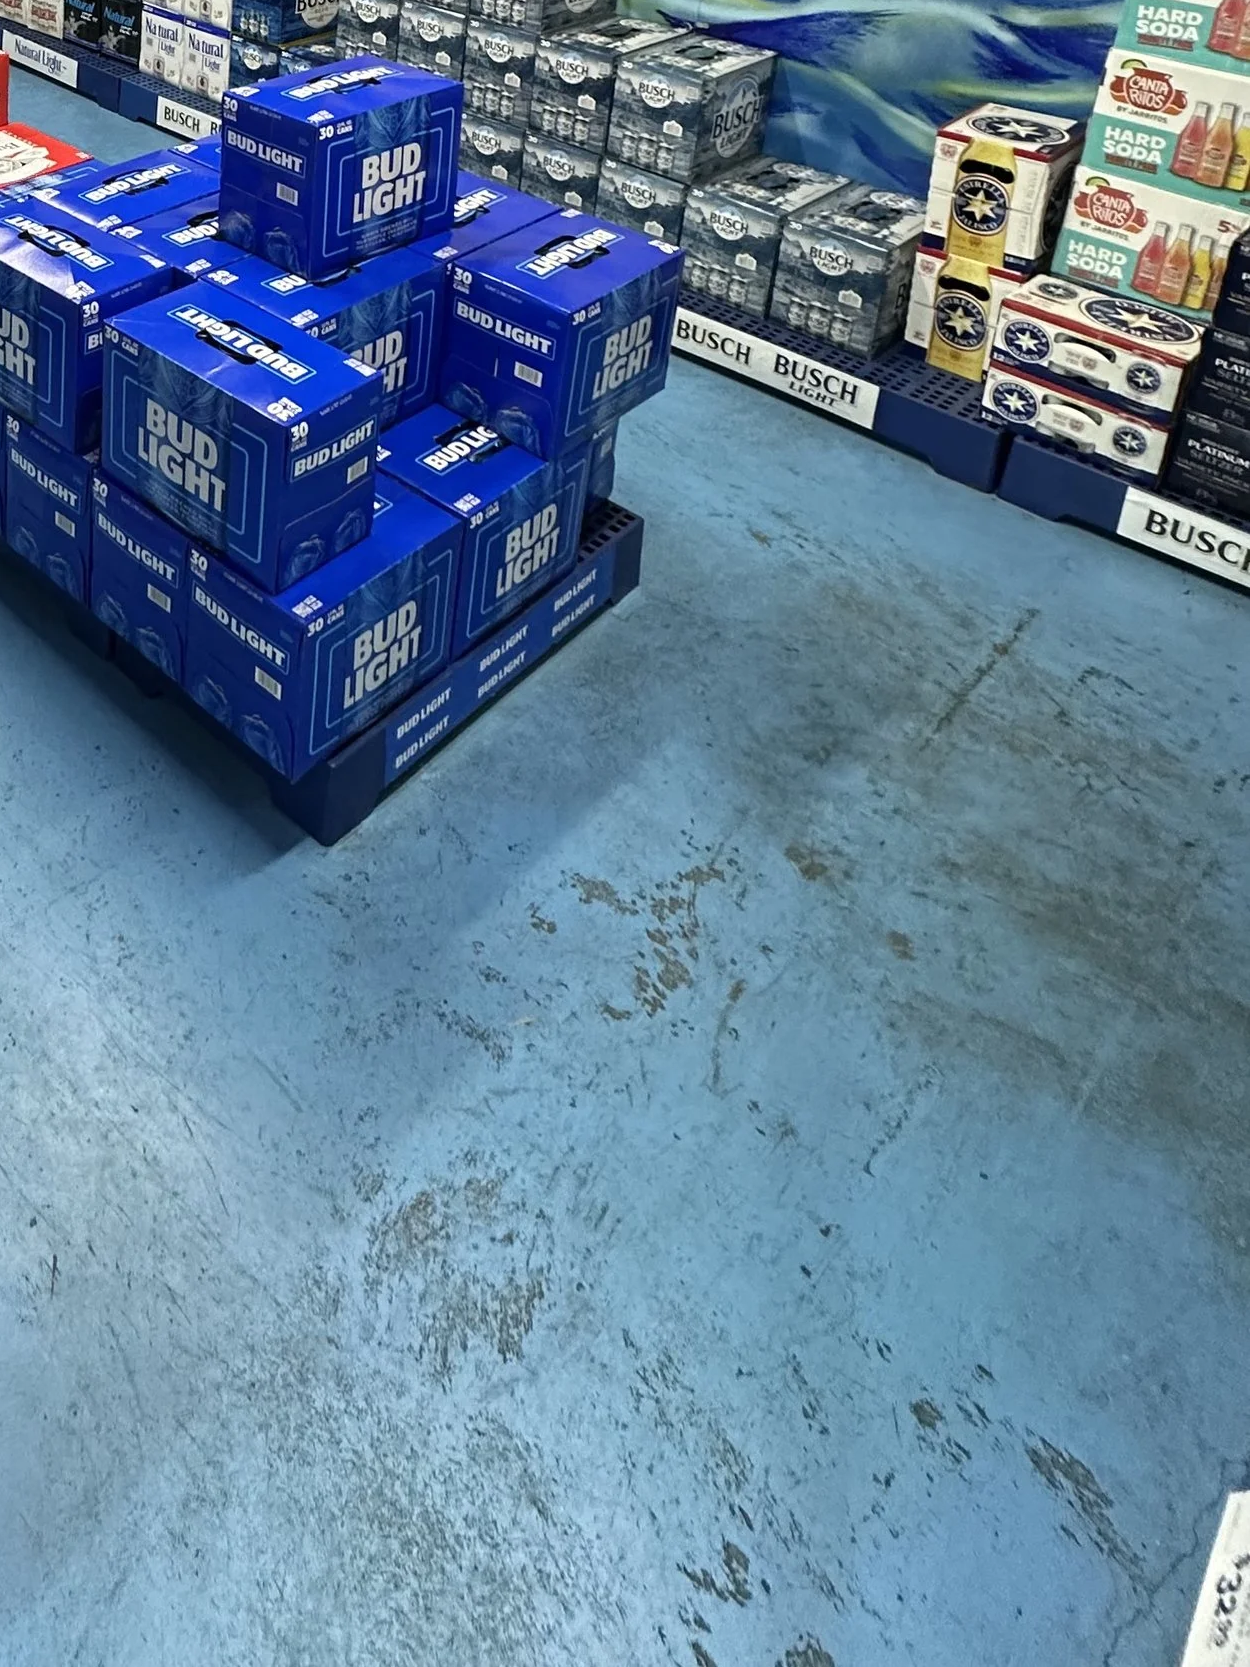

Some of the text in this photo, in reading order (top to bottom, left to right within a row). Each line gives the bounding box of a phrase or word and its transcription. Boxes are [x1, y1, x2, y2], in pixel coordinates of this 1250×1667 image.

[103, 5, 136, 28] Natural
[1137, 5, 1203, 25] HARD
[1135, 20, 1199, 41] SODA
[14, 39, 62, 74] Natural Light
[484, 39, 514, 56] BUSCH
[204, 56, 222, 74] Light
[638, 82, 676, 100] BUSCH
[1129, 76, 1169, 94] CANTA
[223, 97, 239, 114] 30
[164, 104, 200, 137] BUSCH
[318, 123, 335, 140] 30
[1104, 126, 1167, 150] HARD
[1102, 142, 1162, 165] SODA
[362, 142, 423, 189] BUD
[352, 173, 427, 224] LIGHT
[621, 181, 656, 203] BUSCH
[1092, 193, 1131, 213] CANTA
[710, 212, 748, 234] BUSCH
[809, 247, 853, 269] BUSCH
[1069, 242, 1127, 266] HARD
[453, 269, 472, 285] 30
[1066, 255, 1123, 279] SODA
[83, 302, 99, 317] 30
[456, 302, 552, 355] BUD LIGHT
[604, 315, 652, 362] BUD
[676, 318, 858, 405] BUSCH BUSCH
[789, 381, 835, 407] LIGHT
[6, 415, 20, 433] 30
[145, 398, 219, 470] BUD
[290, 423, 309, 441] 30
[1188, 439, 1250, 468] PLATINUM
[138, 425, 226, 513] LIGHT
[469, 512, 484, 529] 30
[506, 502, 558, 562] BUD
[190, 549, 208, 571] 30
[496, 528, 560, 598] LIGHT
[194, 587, 286, 667] BUD LIGHT
[307, 621, 324, 637] 30
[354, 600, 417, 670] BUD
[343, 625, 422, 709] LIGHT
